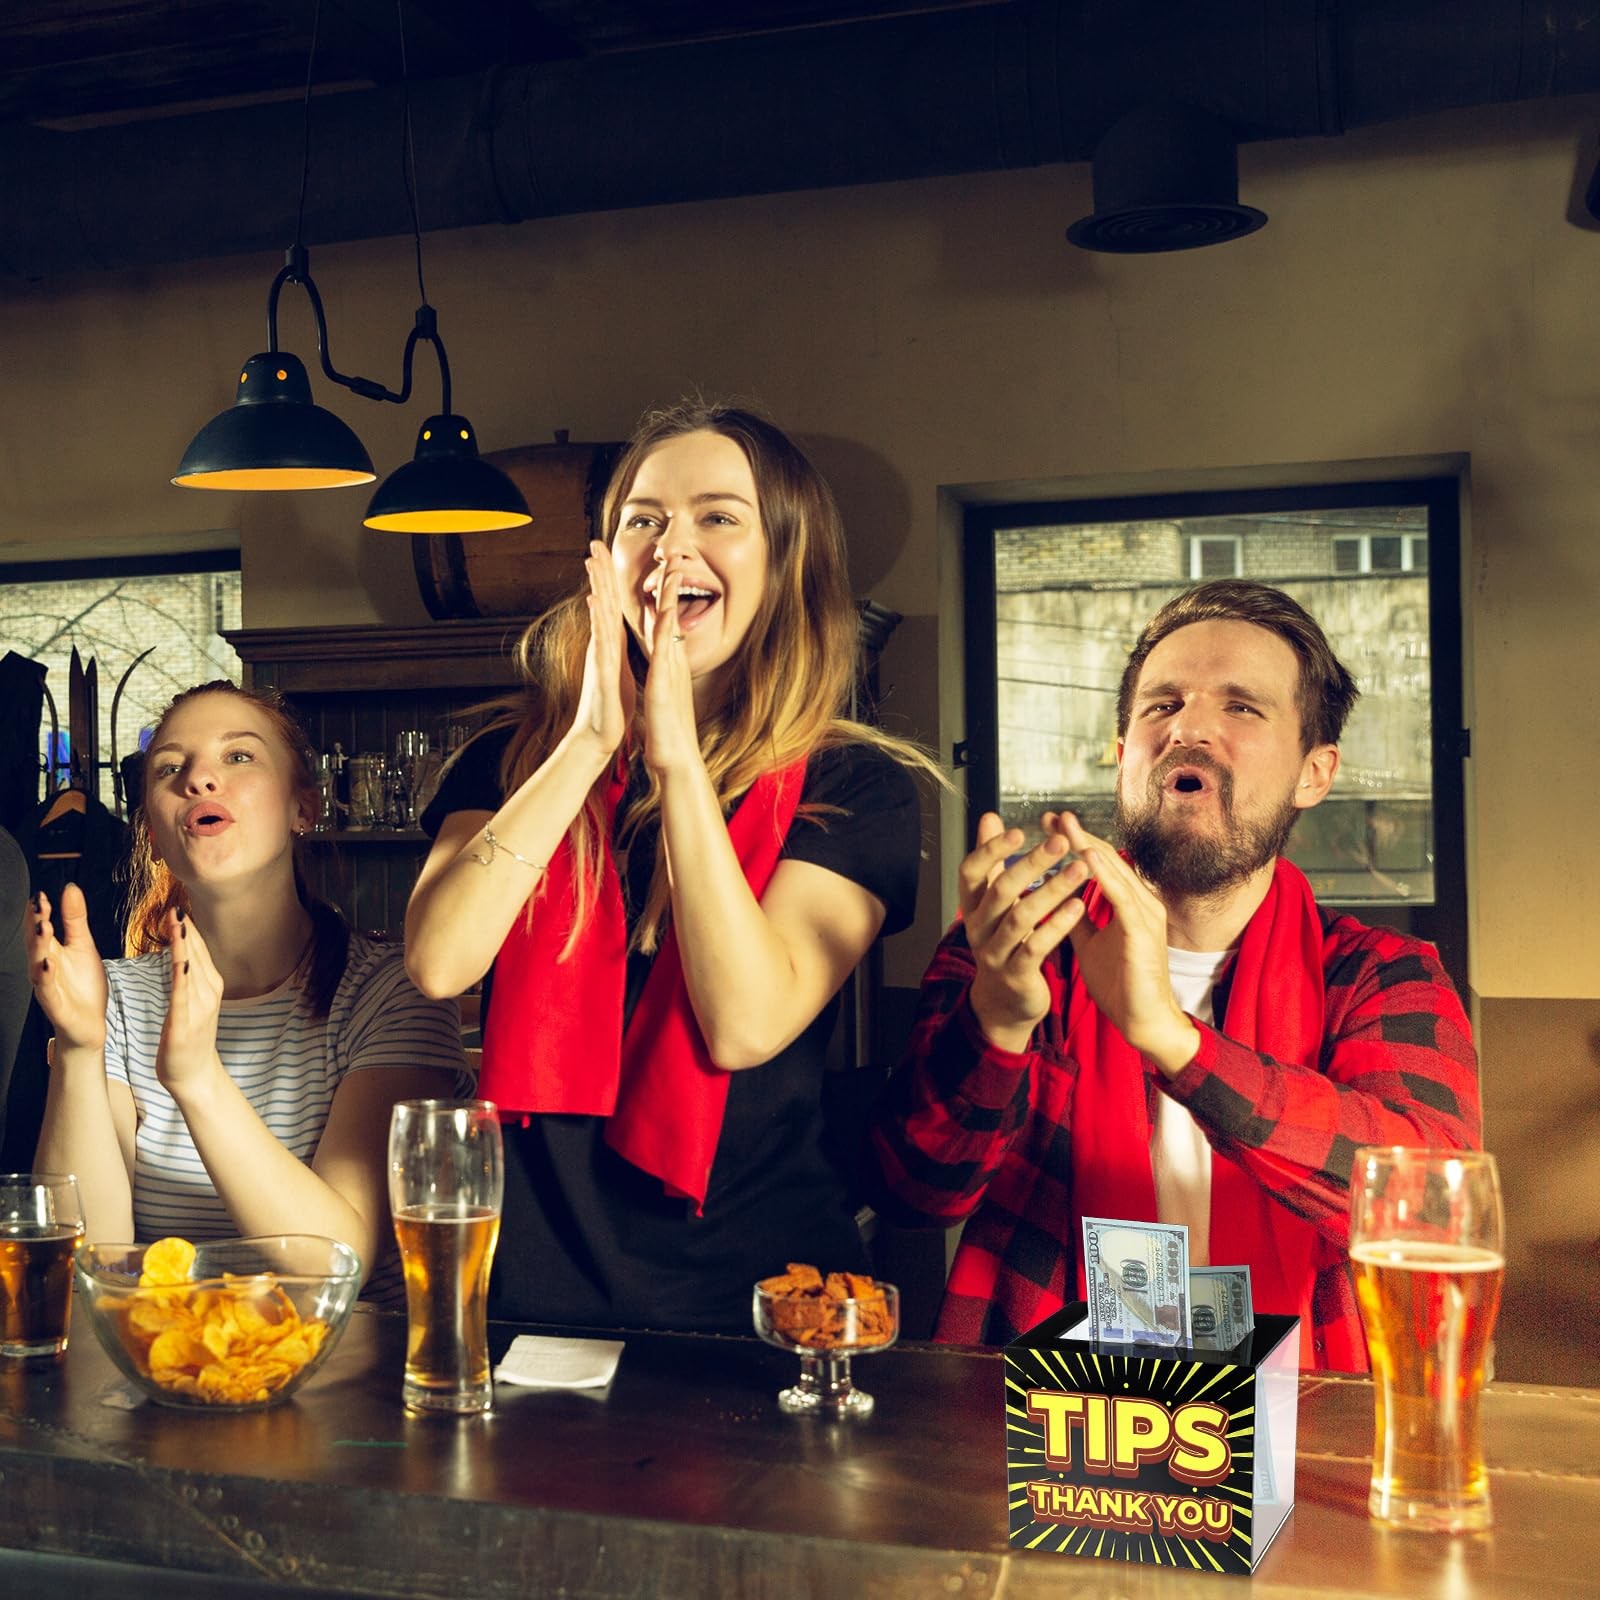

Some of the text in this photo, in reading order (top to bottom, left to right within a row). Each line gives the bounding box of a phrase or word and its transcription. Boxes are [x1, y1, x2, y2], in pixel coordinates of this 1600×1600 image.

[1088, 1231, 1100, 1265] 100
[1167, 1240, 1179, 1283] 100
[1027, 1391, 1230, 1480] TIPS
[1028, 1483, 1230, 1536] THANK YOU
